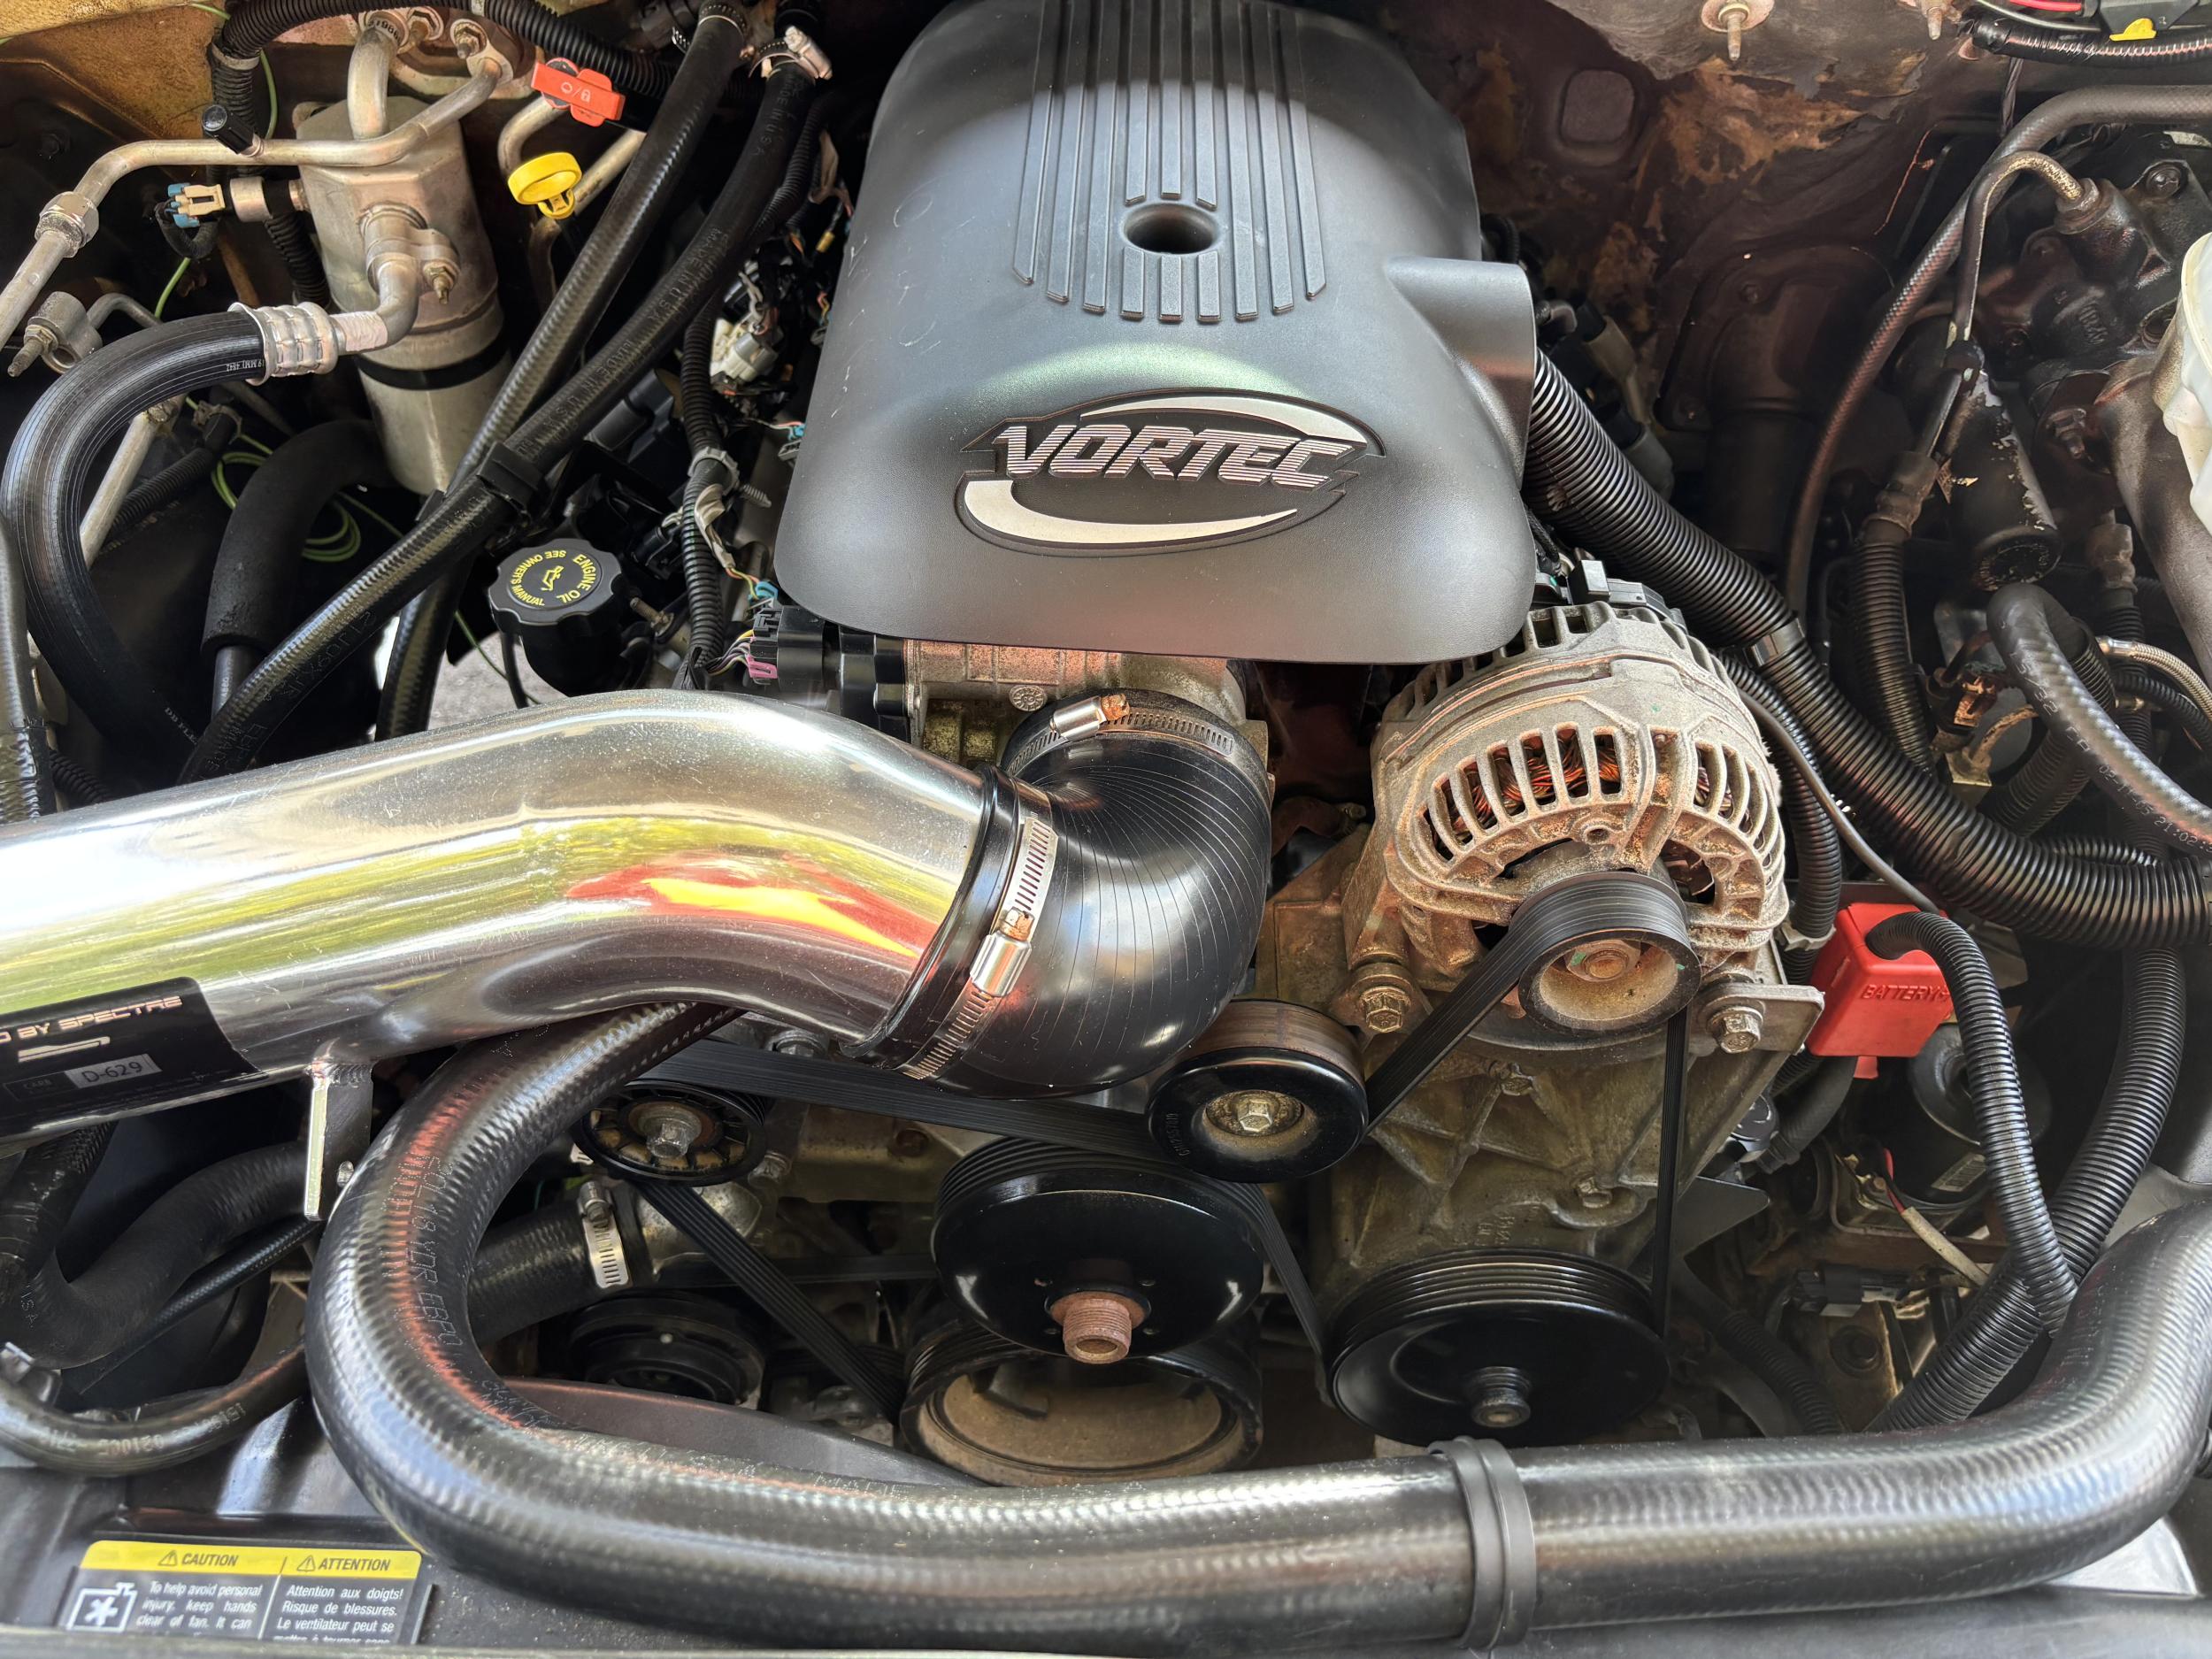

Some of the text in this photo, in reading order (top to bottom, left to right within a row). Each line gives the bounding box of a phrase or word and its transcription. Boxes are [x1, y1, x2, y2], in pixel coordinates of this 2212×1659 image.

[993, 424, 1356, 491] VORTEC
[544, 549, 567, 559] SEE
[557, 554, 596, 603] ENGINE OIL
[511, 585, 545, 606] MANUAL
[17, 1023, 50, 1040] BY
[58, 995, 183, 1031] SPECTRE
[81, 1062, 142, 1083] D-629
[181, 1554, 239, 1567] CAUTION
[319, 1558, 391, 1571] ATTENTION
[149, 1581, 264, 1599] To help avoid personal
[286, 1585, 404, 1603] Attention aux doigts!
[186, 1600, 214, 1615] keep
[223, 1601, 257, 1614] hands
[281, 1601, 398, 1617] Risque de blessures.
[135, 1614, 164, 1628] clear
[170, 1615, 184, 1629] of
[230, 1618, 254, 1630] can
[276, 1617, 395, 1635] Le ventilateur peut se
